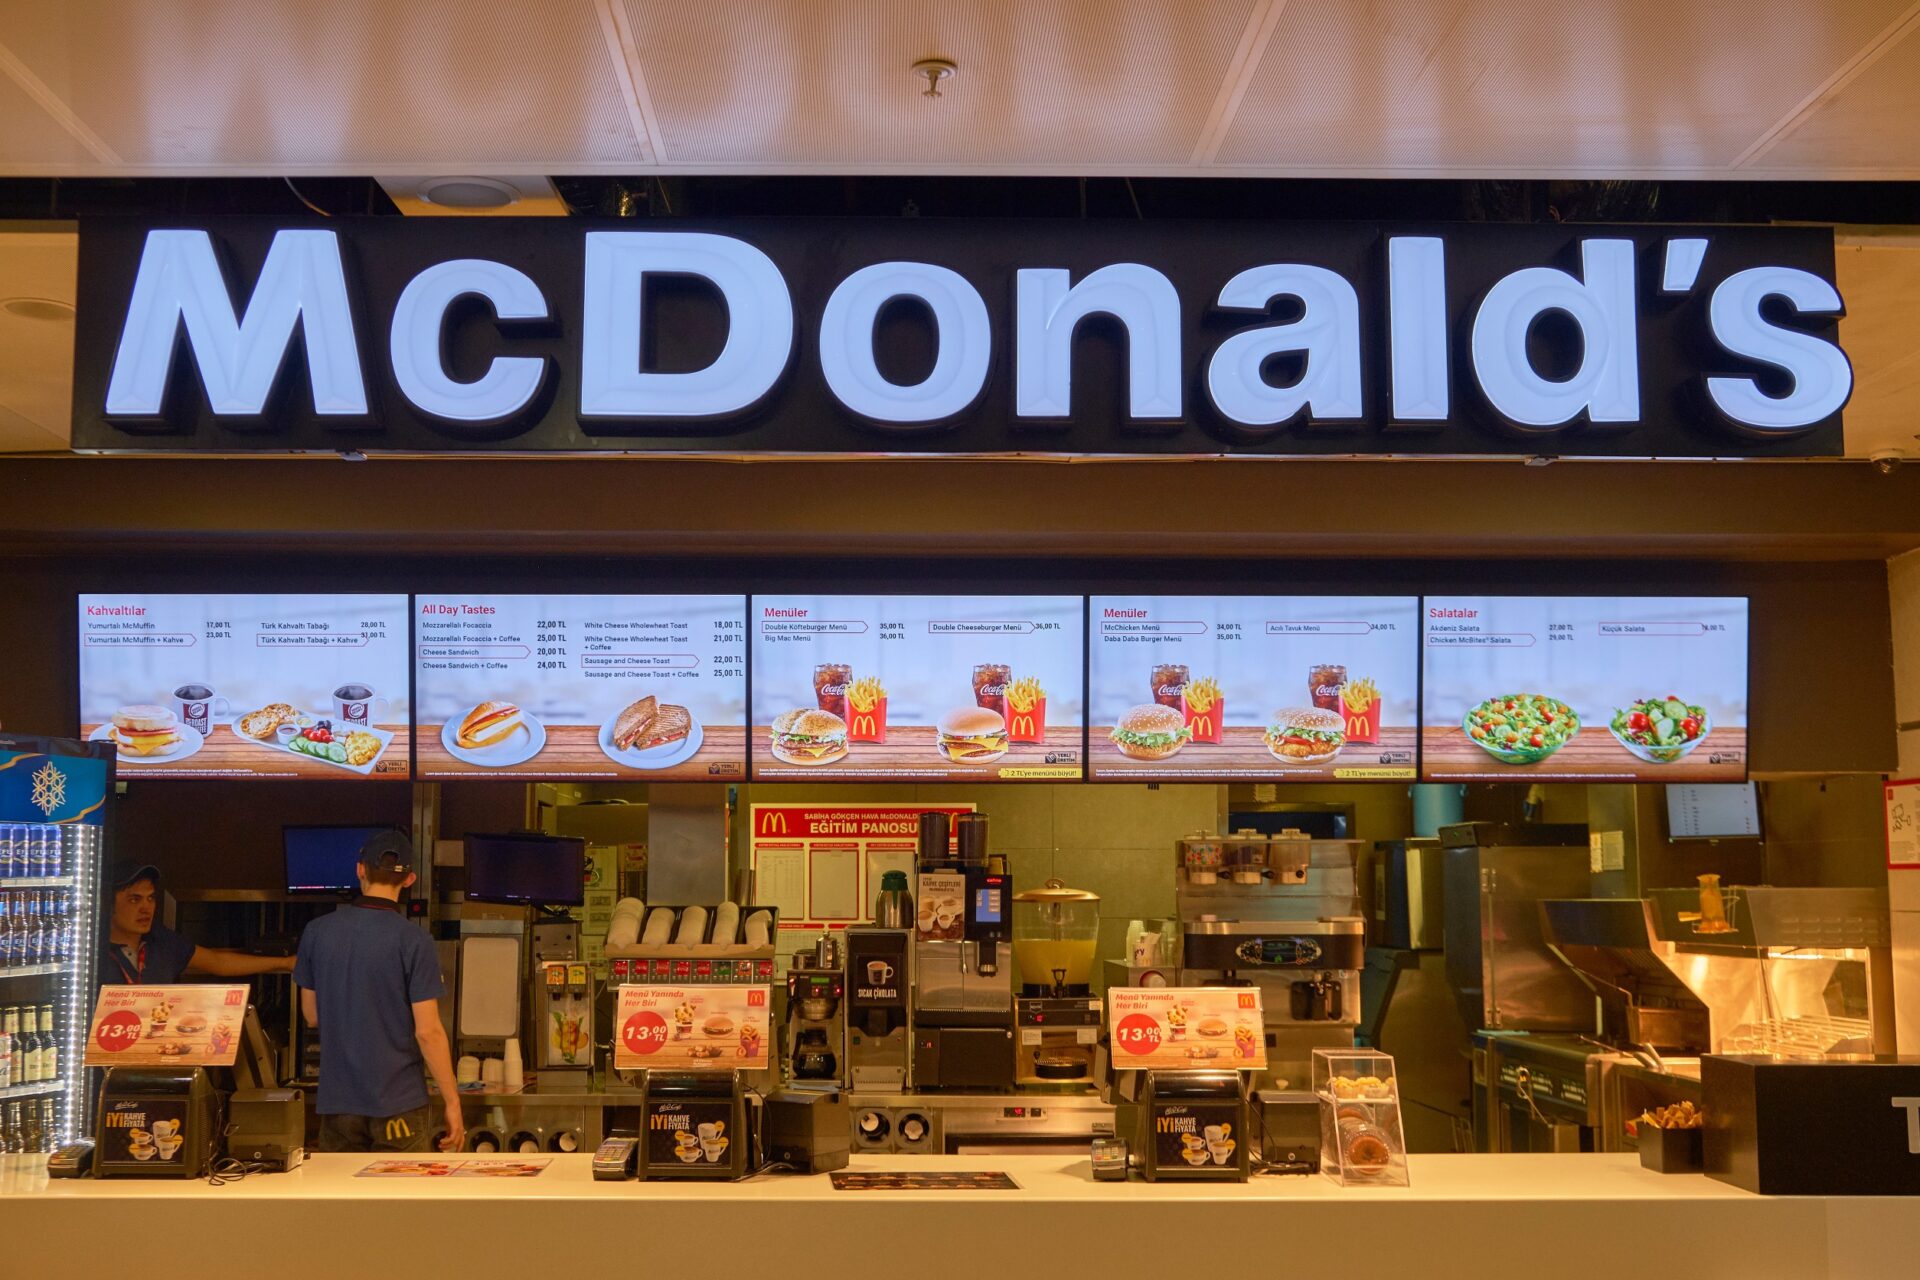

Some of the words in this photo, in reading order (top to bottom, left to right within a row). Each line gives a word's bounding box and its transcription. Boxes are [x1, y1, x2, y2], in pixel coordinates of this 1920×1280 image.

[104, 229, 1853, 430] McDonald's
[88, 606, 146, 615] Kahvaltılar
[423, 605, 435, 614] All
[439, 605, 458, 616] Day
[462, 605, 495, 614] Tastes
[765, 608, 807, 617] Menüler
[1104, 608, 1147, 618] Menüler
[1430, 608, 1478, 618] Salatalar
[537, 621, 556, 629] 22,00
[537, 635, 556, 643] 25,00
[537, 648, 556, 656] 20,00
[831, 813, 860, 821] GÖKÇEN
[810, 822, 857, 834] EĞİTİM
[862, 823, 917, 834] PANOSU
[858, 988, 872, 998] SICAK
